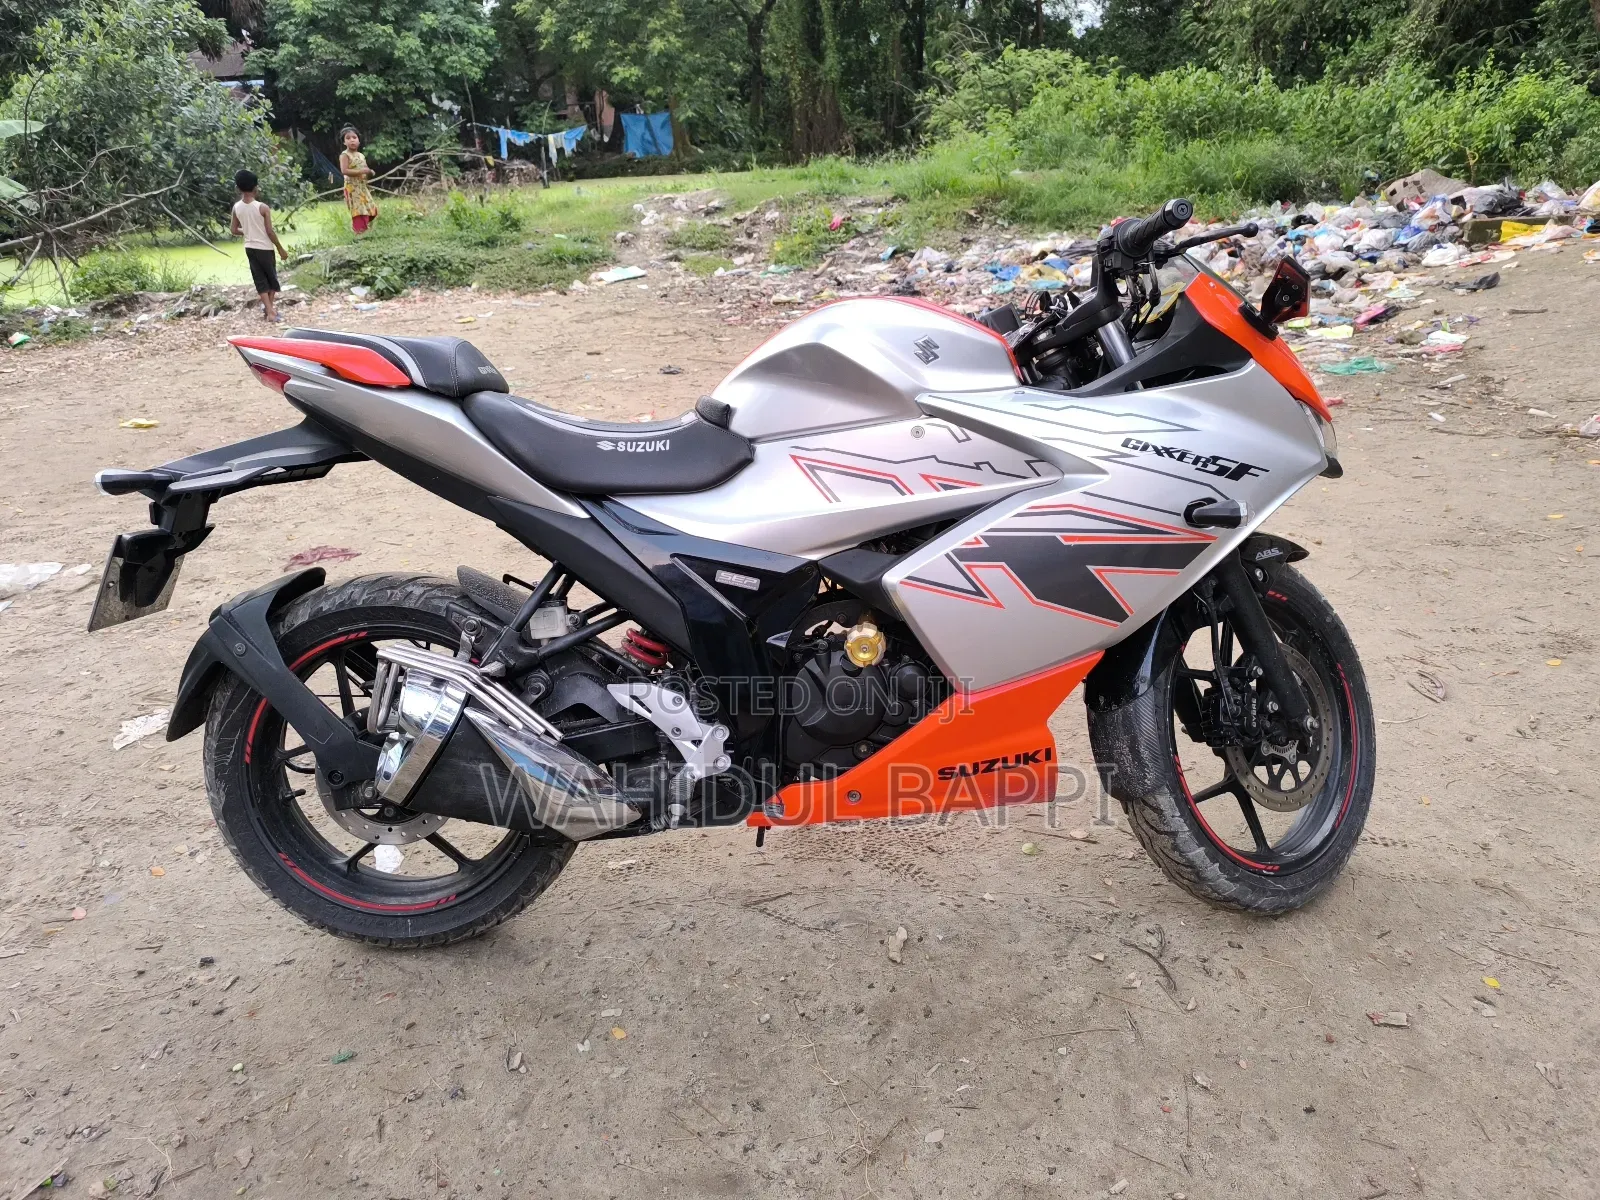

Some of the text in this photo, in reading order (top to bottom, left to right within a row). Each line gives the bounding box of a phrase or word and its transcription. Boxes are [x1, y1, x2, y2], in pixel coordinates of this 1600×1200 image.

[616, 440, 671, 453] SUZUKI
[1255, 547, 1283, 561] ABS
[719, 572, 758, 584] SEP
[937, 747, 1052, 781] SUZUKI
